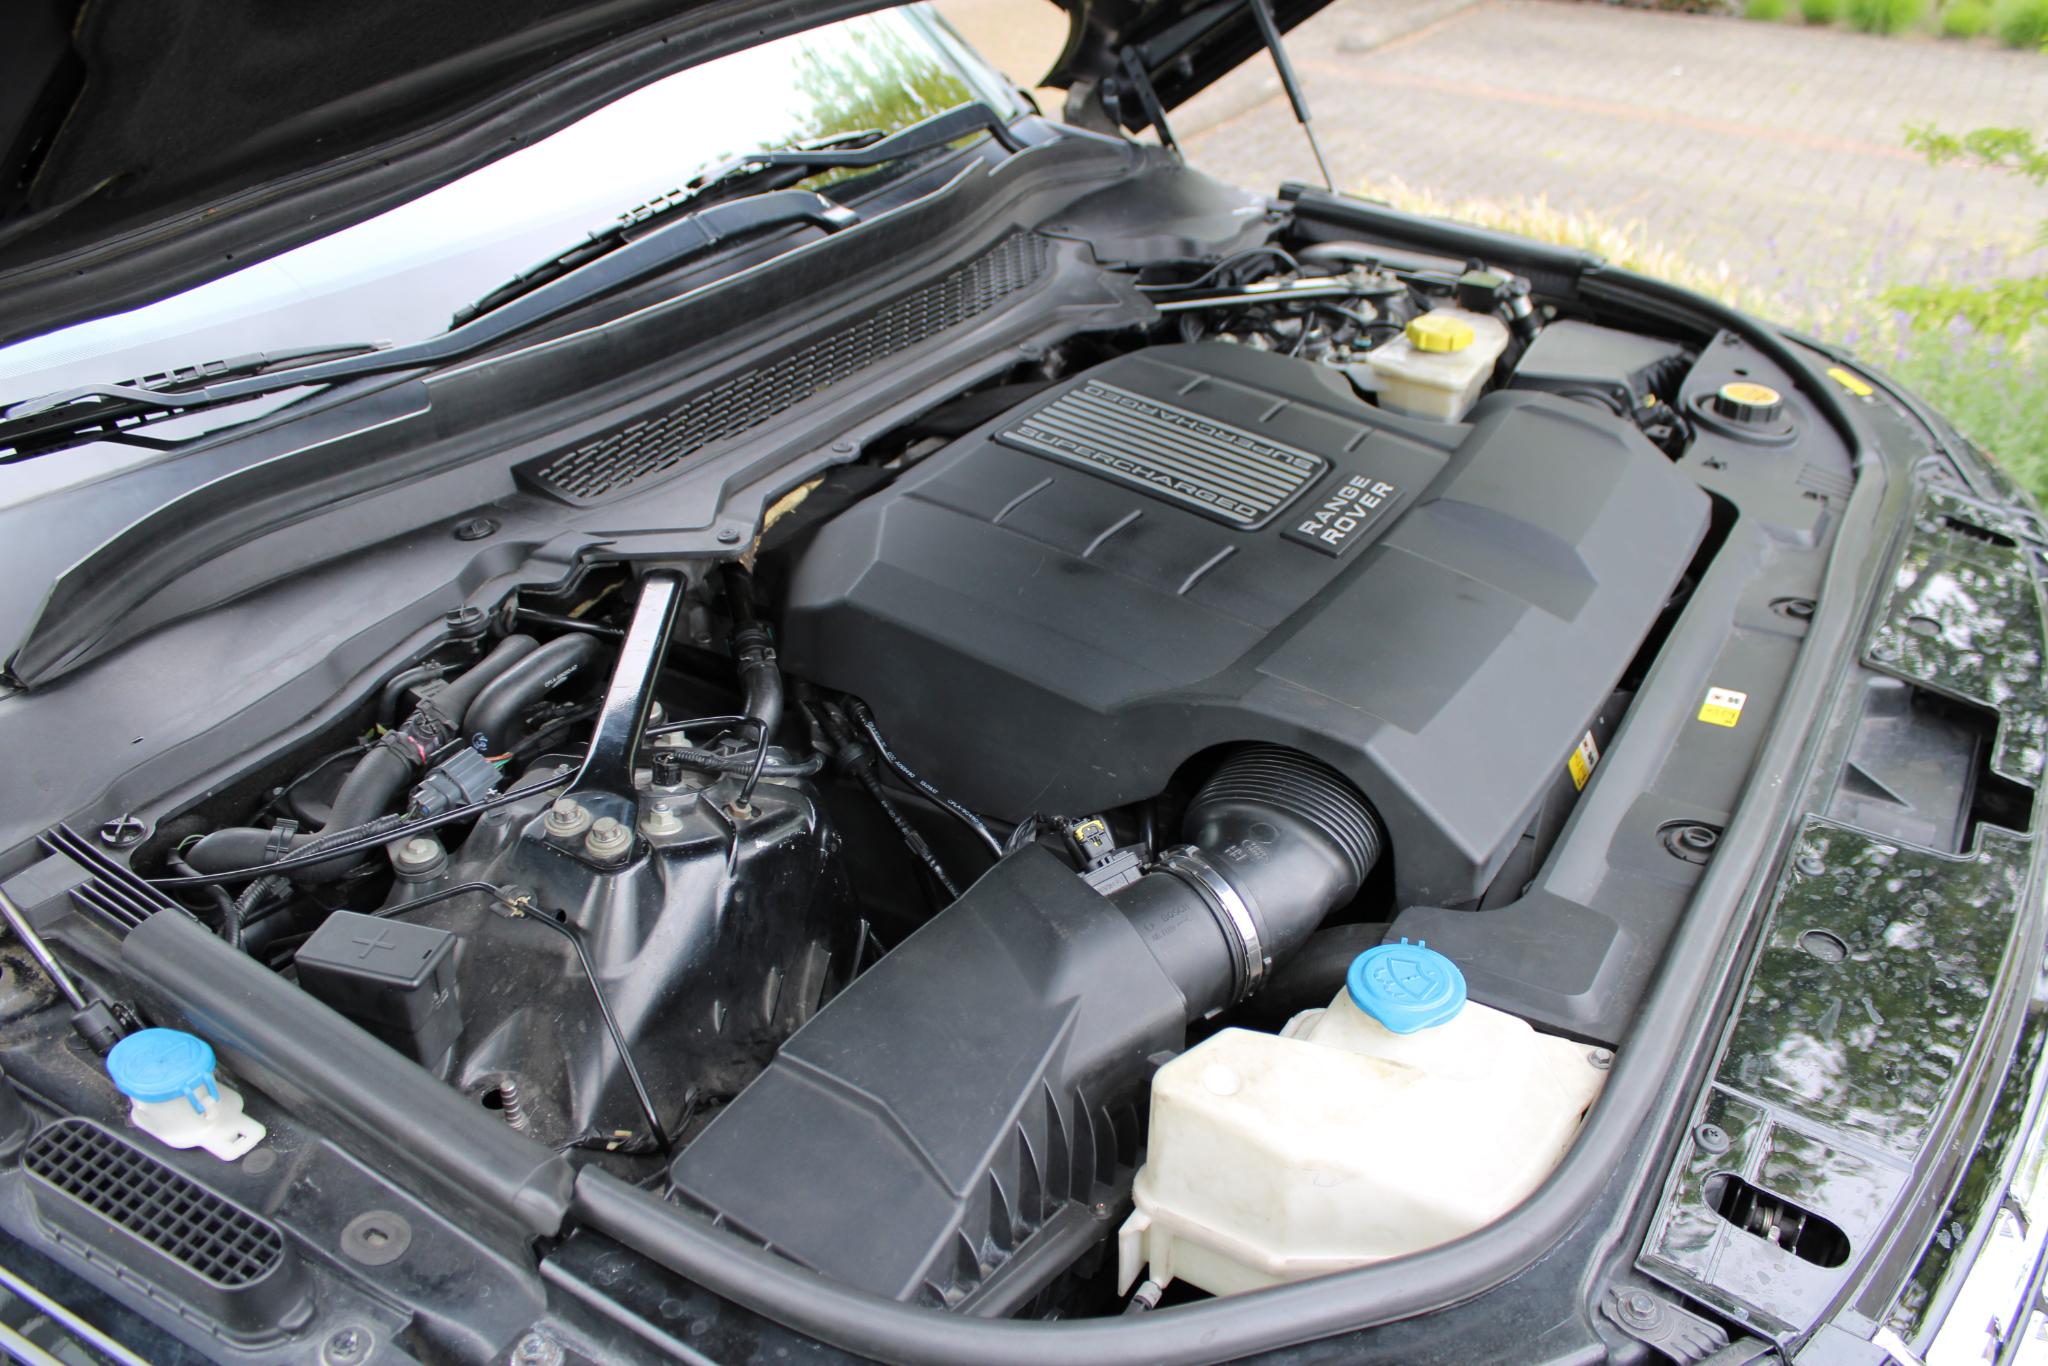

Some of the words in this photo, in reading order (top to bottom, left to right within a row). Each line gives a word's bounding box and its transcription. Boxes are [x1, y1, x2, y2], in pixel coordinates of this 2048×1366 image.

[1083, 385, 1315, 471] SUPERCHARGED
[1016, 426, 1259, 518] SUPERCHARGED
[1297, 474, 1372, 537] RANGE
[1319, 481, 1395, 546] ROVER
